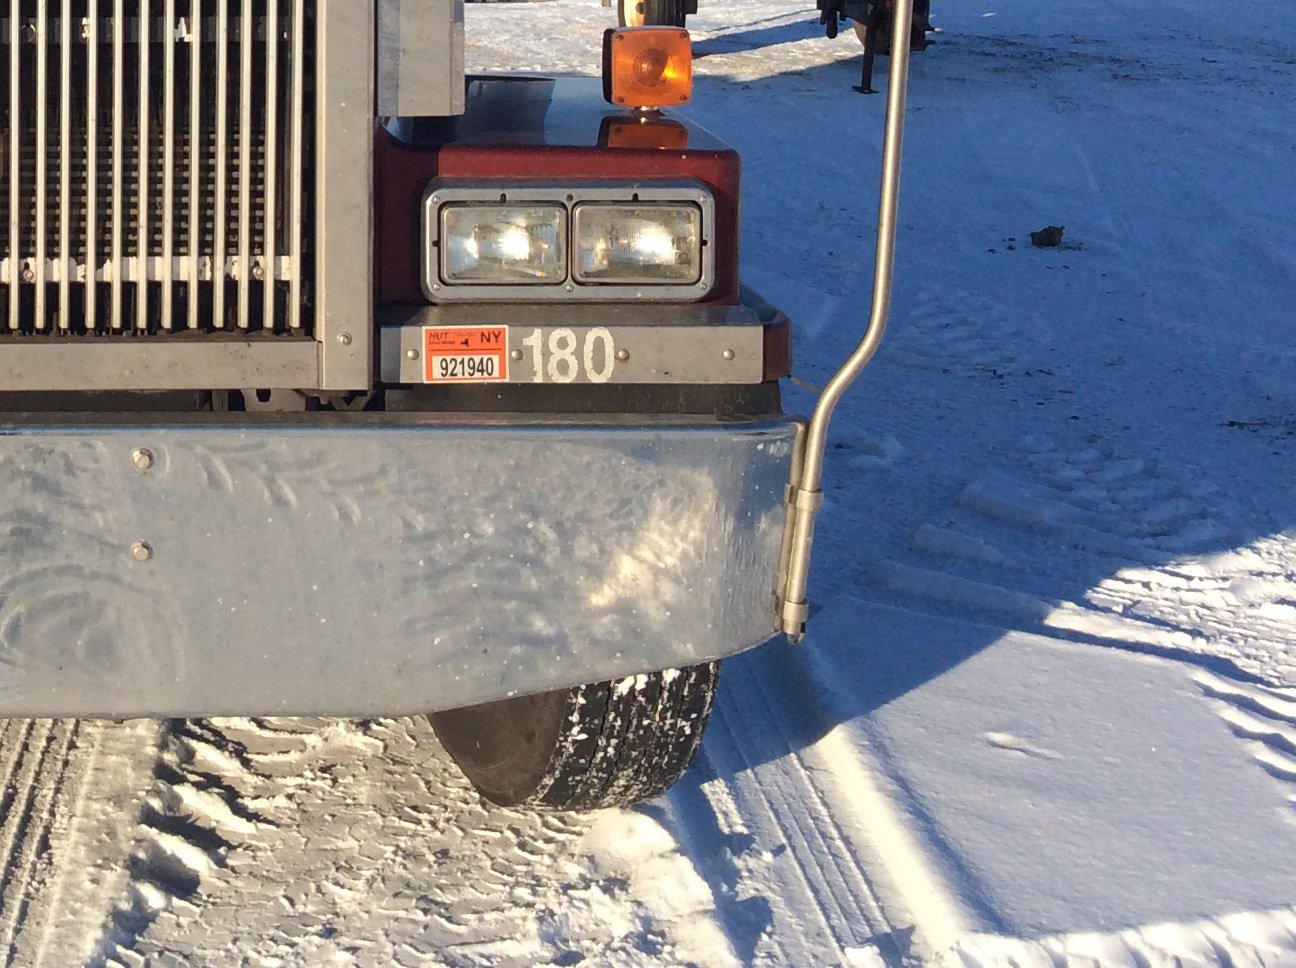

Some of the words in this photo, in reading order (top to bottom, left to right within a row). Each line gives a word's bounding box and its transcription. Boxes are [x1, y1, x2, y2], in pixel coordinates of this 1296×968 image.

[429, 332, 449, 340] HUT
[480, 331, 502, 344] NY
[522, 326, 615, 383] 180
[439, 356, 494, 377] 921940
